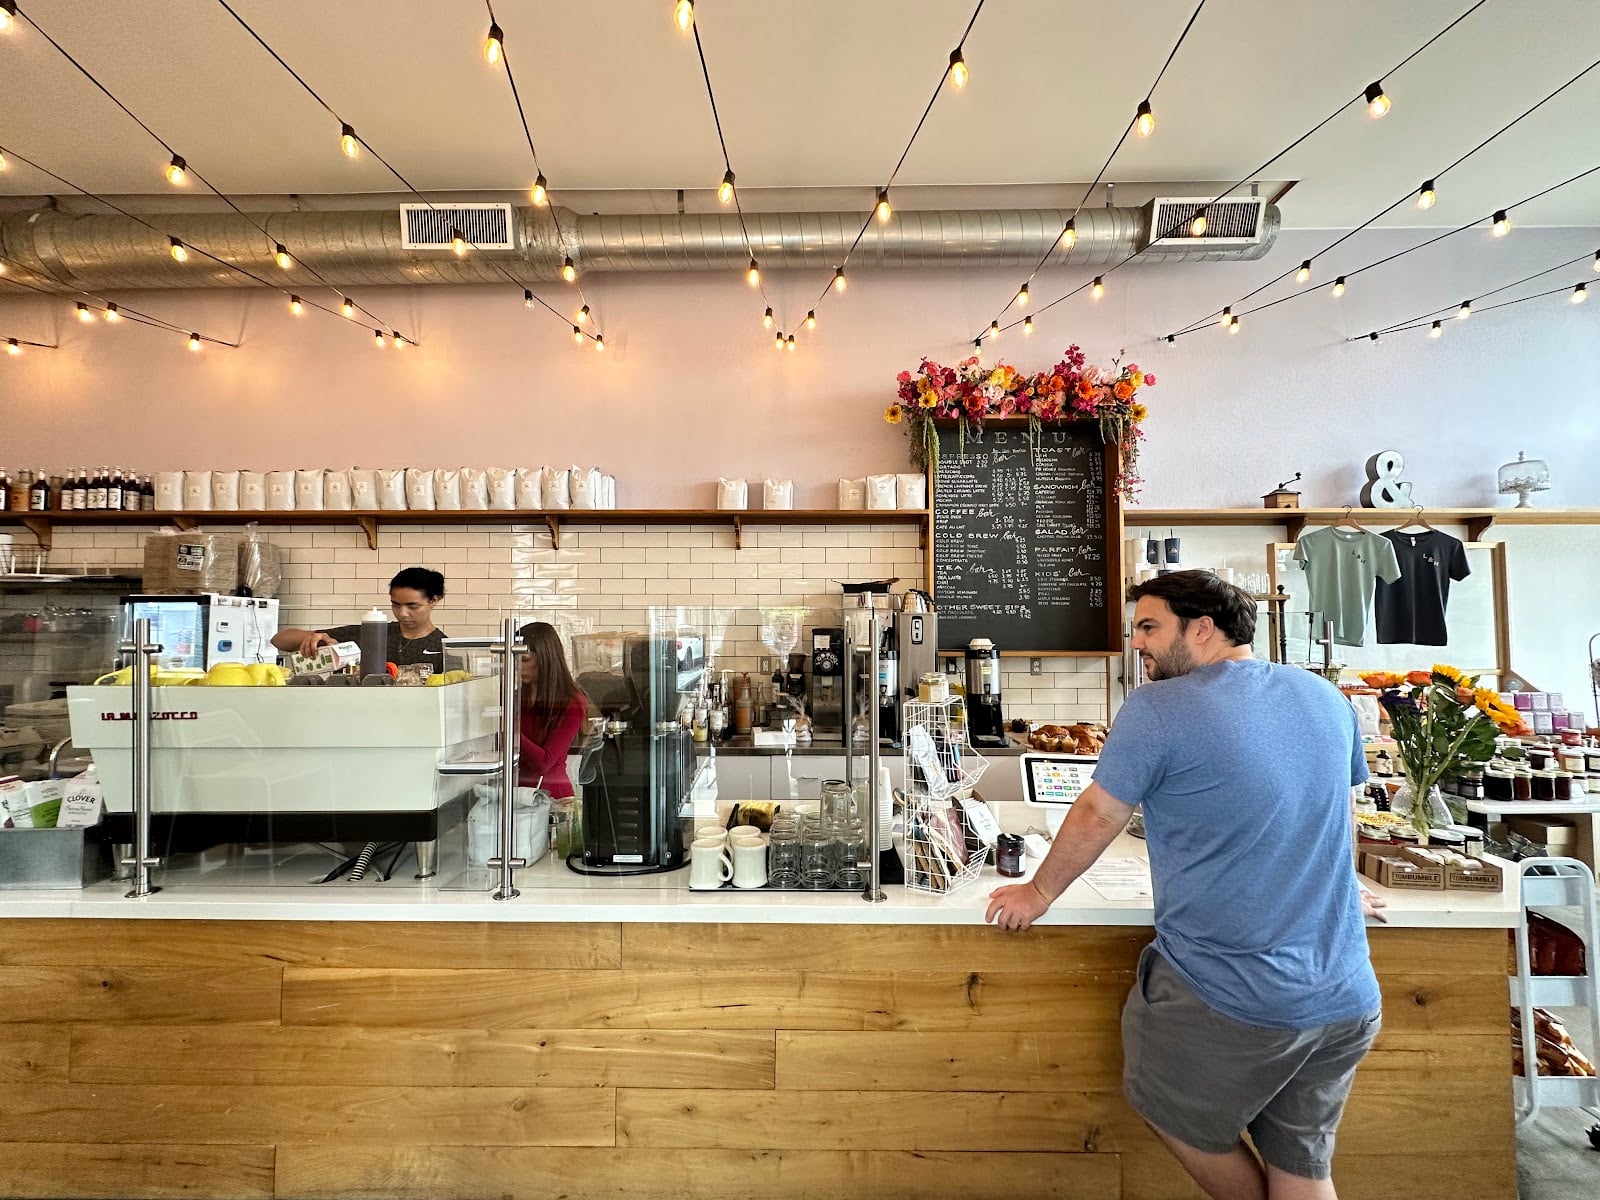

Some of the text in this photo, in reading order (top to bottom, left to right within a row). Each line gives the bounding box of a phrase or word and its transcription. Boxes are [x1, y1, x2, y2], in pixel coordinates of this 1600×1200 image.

[67, 794, 96, 805] CLOVER
[1395, 873, 1438, 882] TOMBUMBLE
[1452, 874, 1496, 883] TOMBUMBLE
